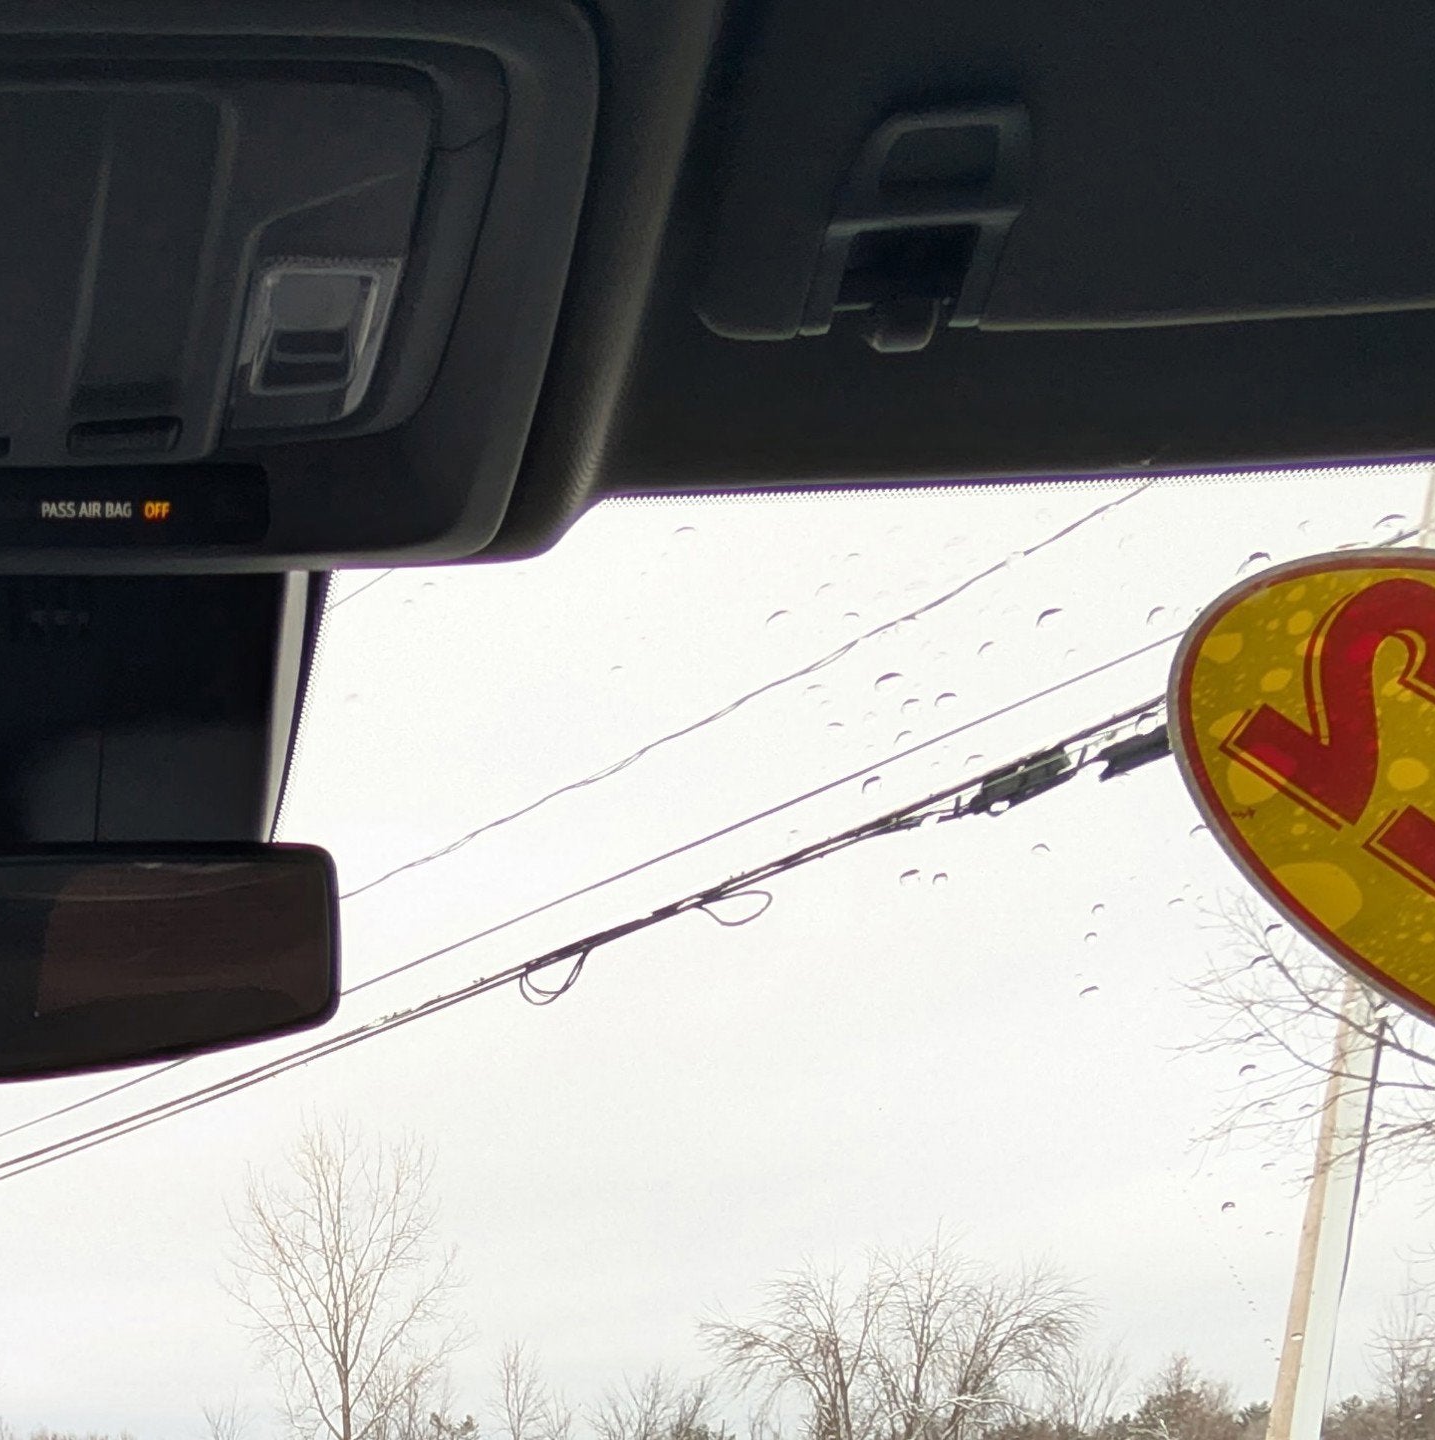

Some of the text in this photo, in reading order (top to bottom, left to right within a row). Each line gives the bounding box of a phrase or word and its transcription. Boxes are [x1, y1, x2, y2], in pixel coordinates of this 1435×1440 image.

[41, 500, 170, 519] PASS AIR BAG OFF
